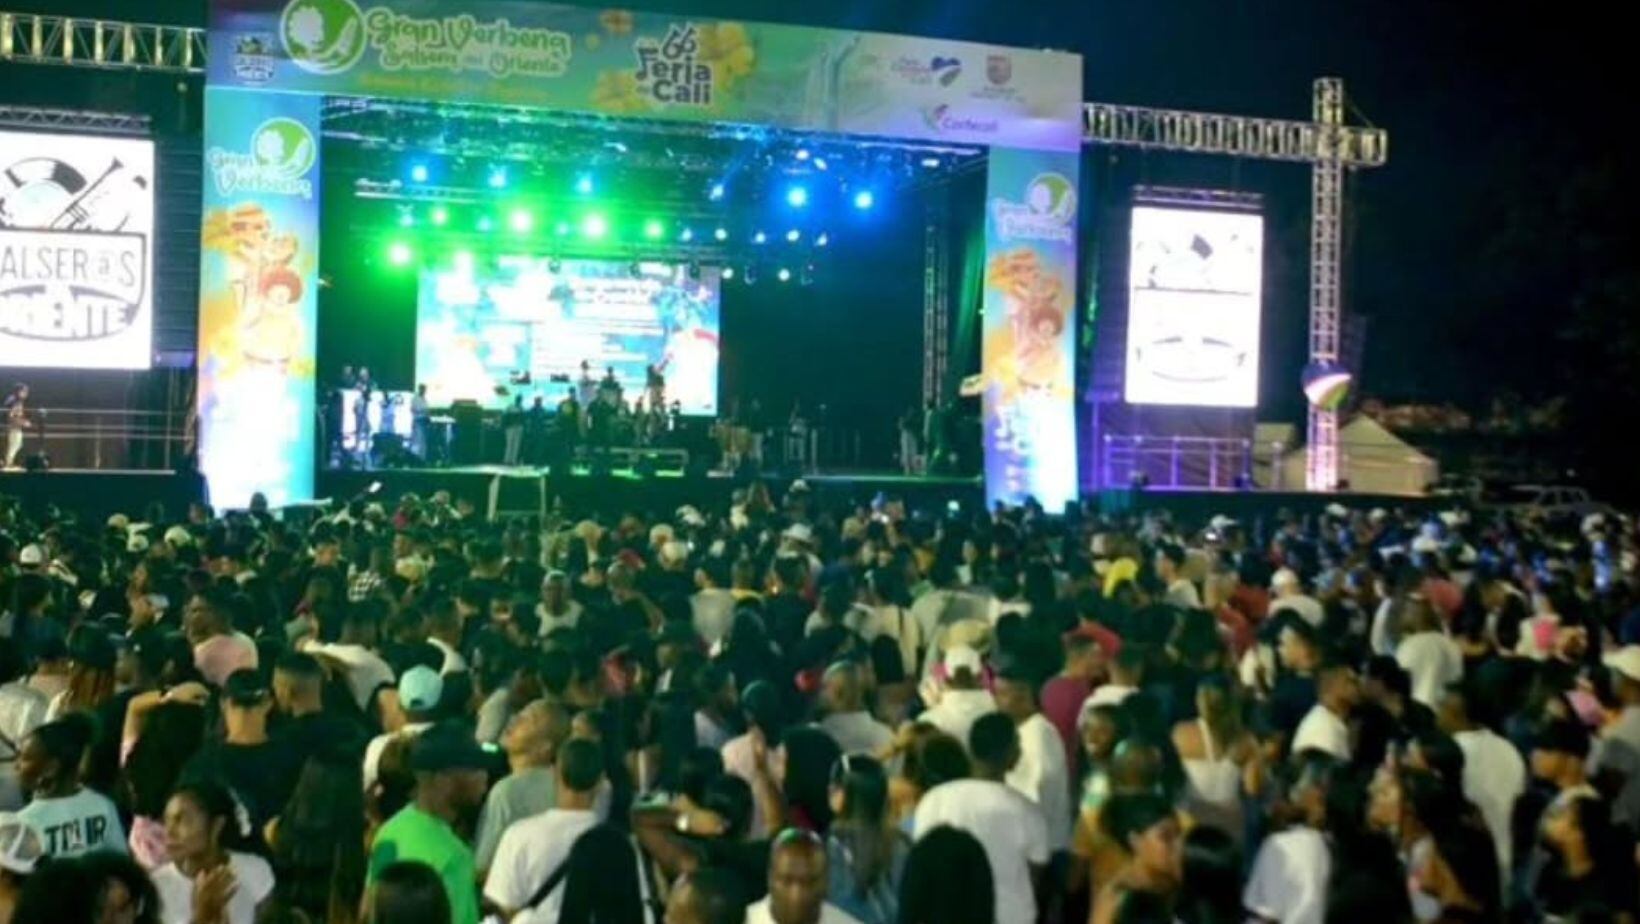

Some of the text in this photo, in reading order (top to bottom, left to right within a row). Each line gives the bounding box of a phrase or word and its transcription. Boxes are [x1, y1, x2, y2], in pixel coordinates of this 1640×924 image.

[367, 10, 570, 57] Gran Verbena
[662, 26, 698, 59] 66
[635, 47, 712, 85] Feria
[652, 79, 711, 106] Cali
